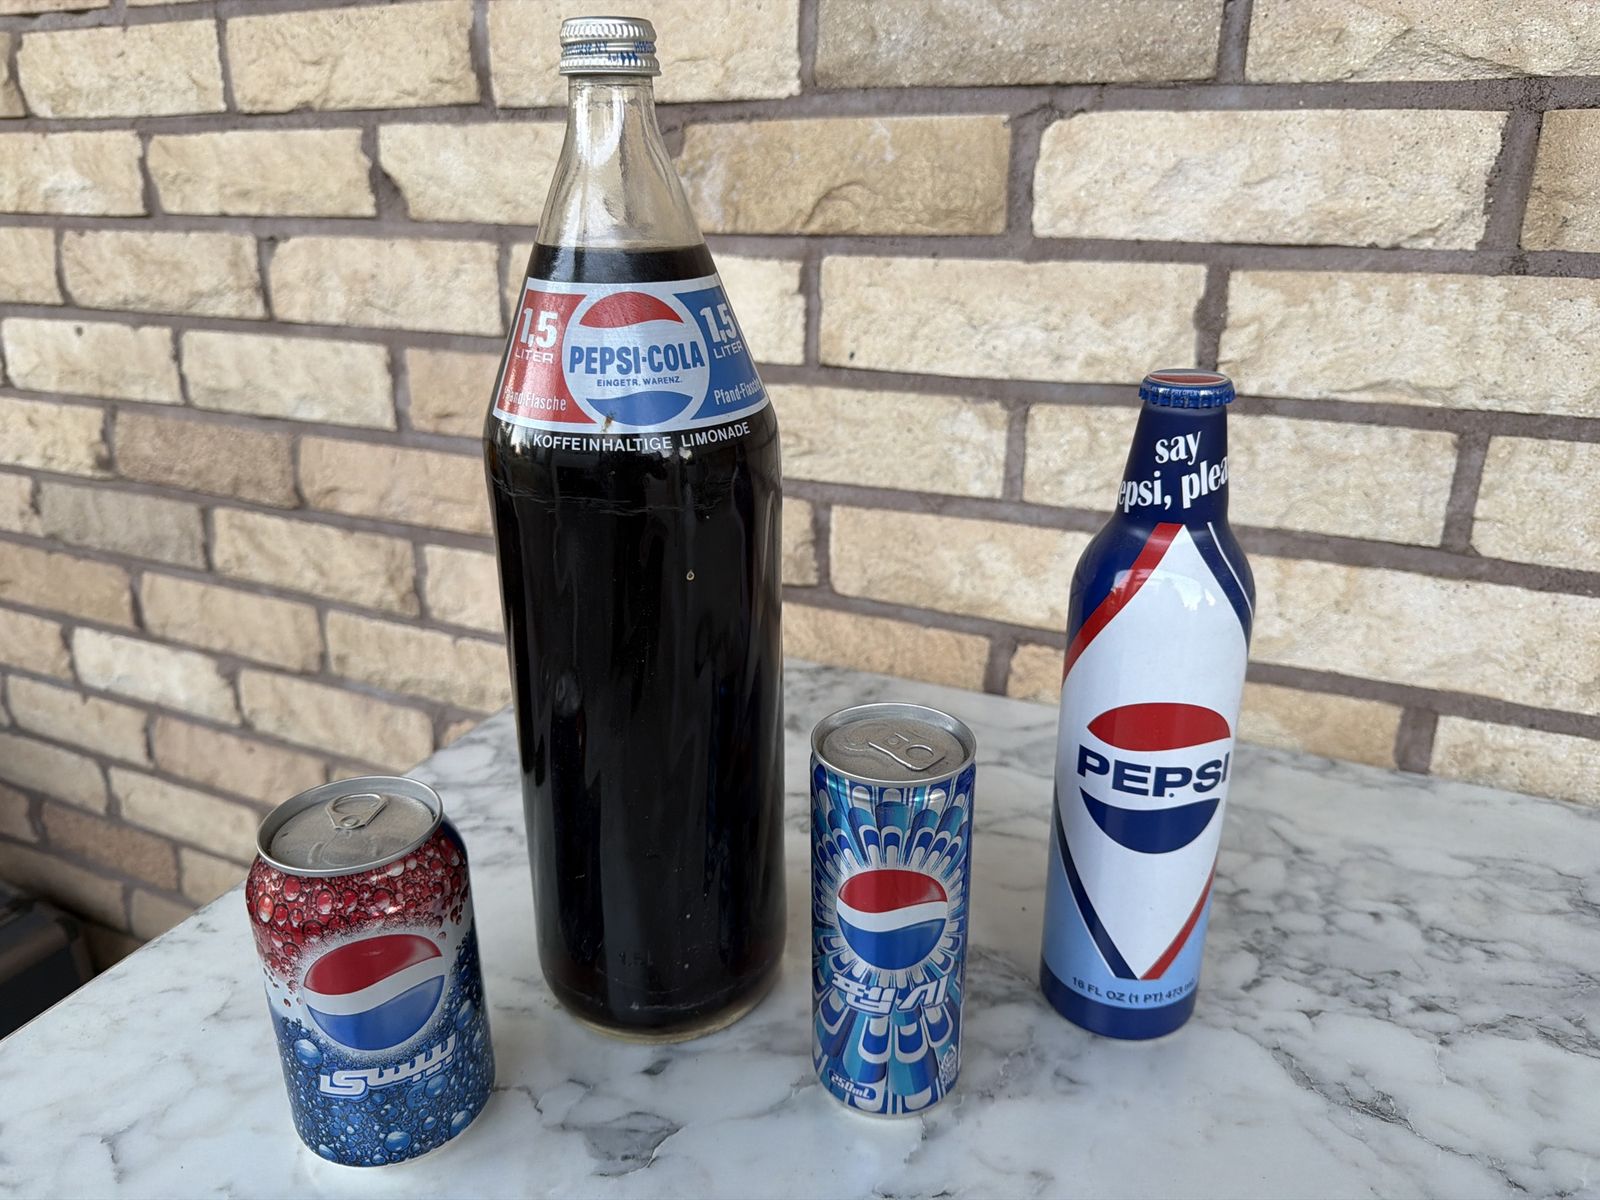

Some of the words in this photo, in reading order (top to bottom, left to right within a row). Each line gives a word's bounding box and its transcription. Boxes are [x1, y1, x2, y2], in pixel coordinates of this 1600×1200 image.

[520, 307, 558, 349] 1,5
[700, 302, 738, 345] 1,5
[514, 349, 554, 364] LITER
[713, 341, 743, 359] LITER
[596, 378, 641, 387] EINGETR.
[642, 376, 682, 386] WARENZ.
[533, 433, 673, 452] KOFFEINHALTIGE
[681, 423, 751, 448] LIMONADE
[1155, 431, 1202, 466] say
[1076, 743, 1230, 798] PEPSI
[1072, 976, 1085, 990] 16
[1087, 983, 1102, 997] FL
[1106, 990, 1125, 1002] OZ
[1165, 987, 1183, 999] 473
